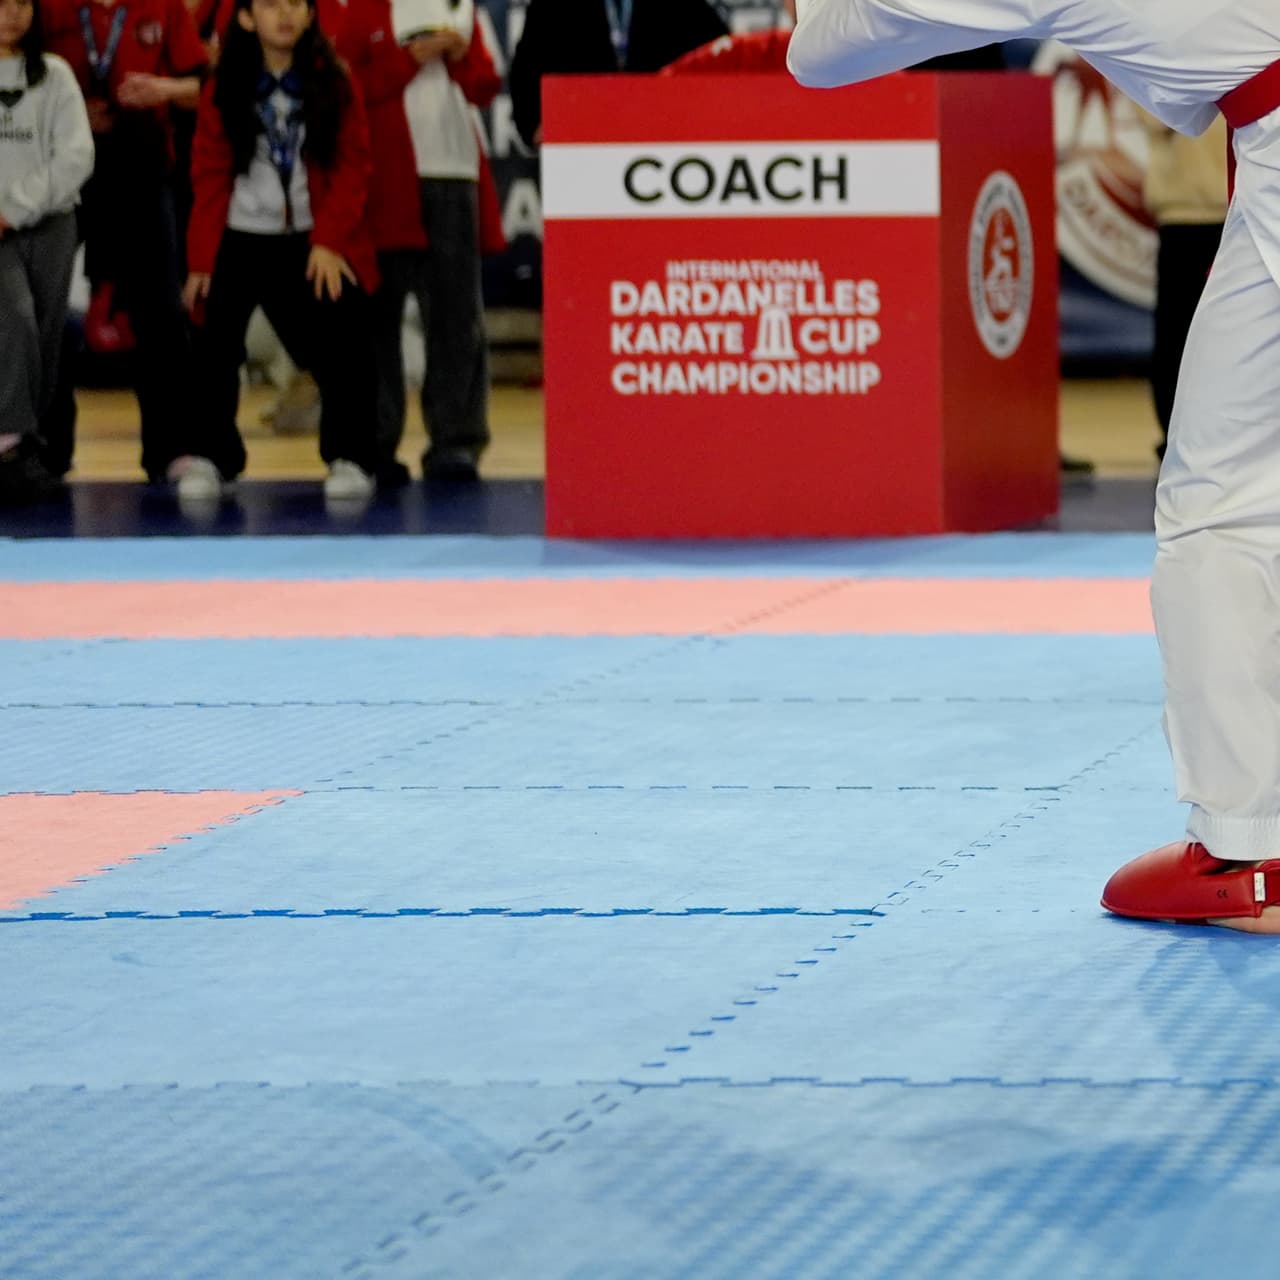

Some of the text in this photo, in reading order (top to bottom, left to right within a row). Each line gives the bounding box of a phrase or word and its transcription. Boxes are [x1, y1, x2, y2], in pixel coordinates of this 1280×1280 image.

[623, 155, 849, 204] COACH
[666, 259, 822, 282] INTERNATIONAL
[610, 279, 880, 316] DARDANELLES
[610, 319, 881, 355] KARATE CUP
[611, 360, 881, 396] CHAMPIONSHIP
